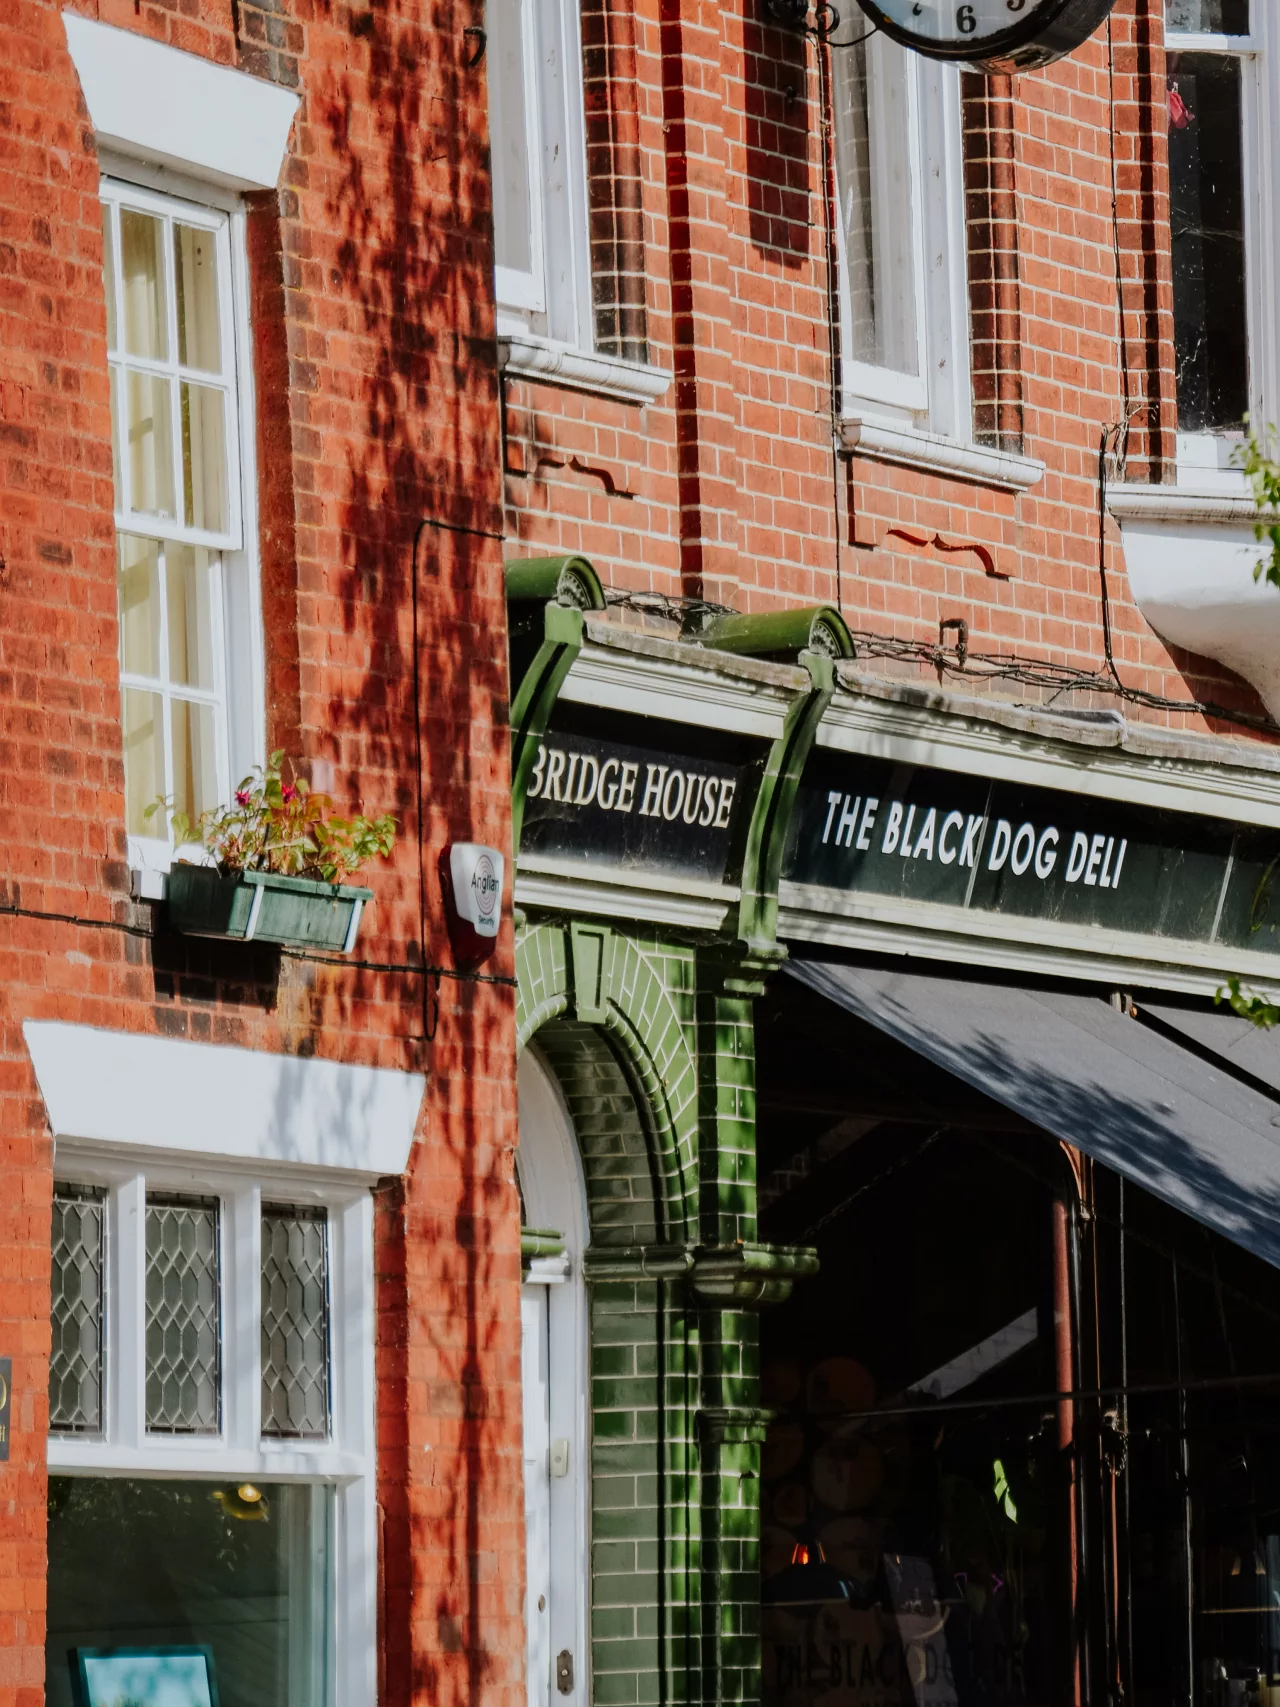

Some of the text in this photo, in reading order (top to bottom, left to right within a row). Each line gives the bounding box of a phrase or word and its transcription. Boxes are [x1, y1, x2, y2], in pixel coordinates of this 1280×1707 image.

[956, 5, 977, 34] 6
[639, 763, 736, 829] HOUSE
[822, 790, 1128, 890] THE BLACK DOG DELI
[471, 872, 500, 894] Anglian
